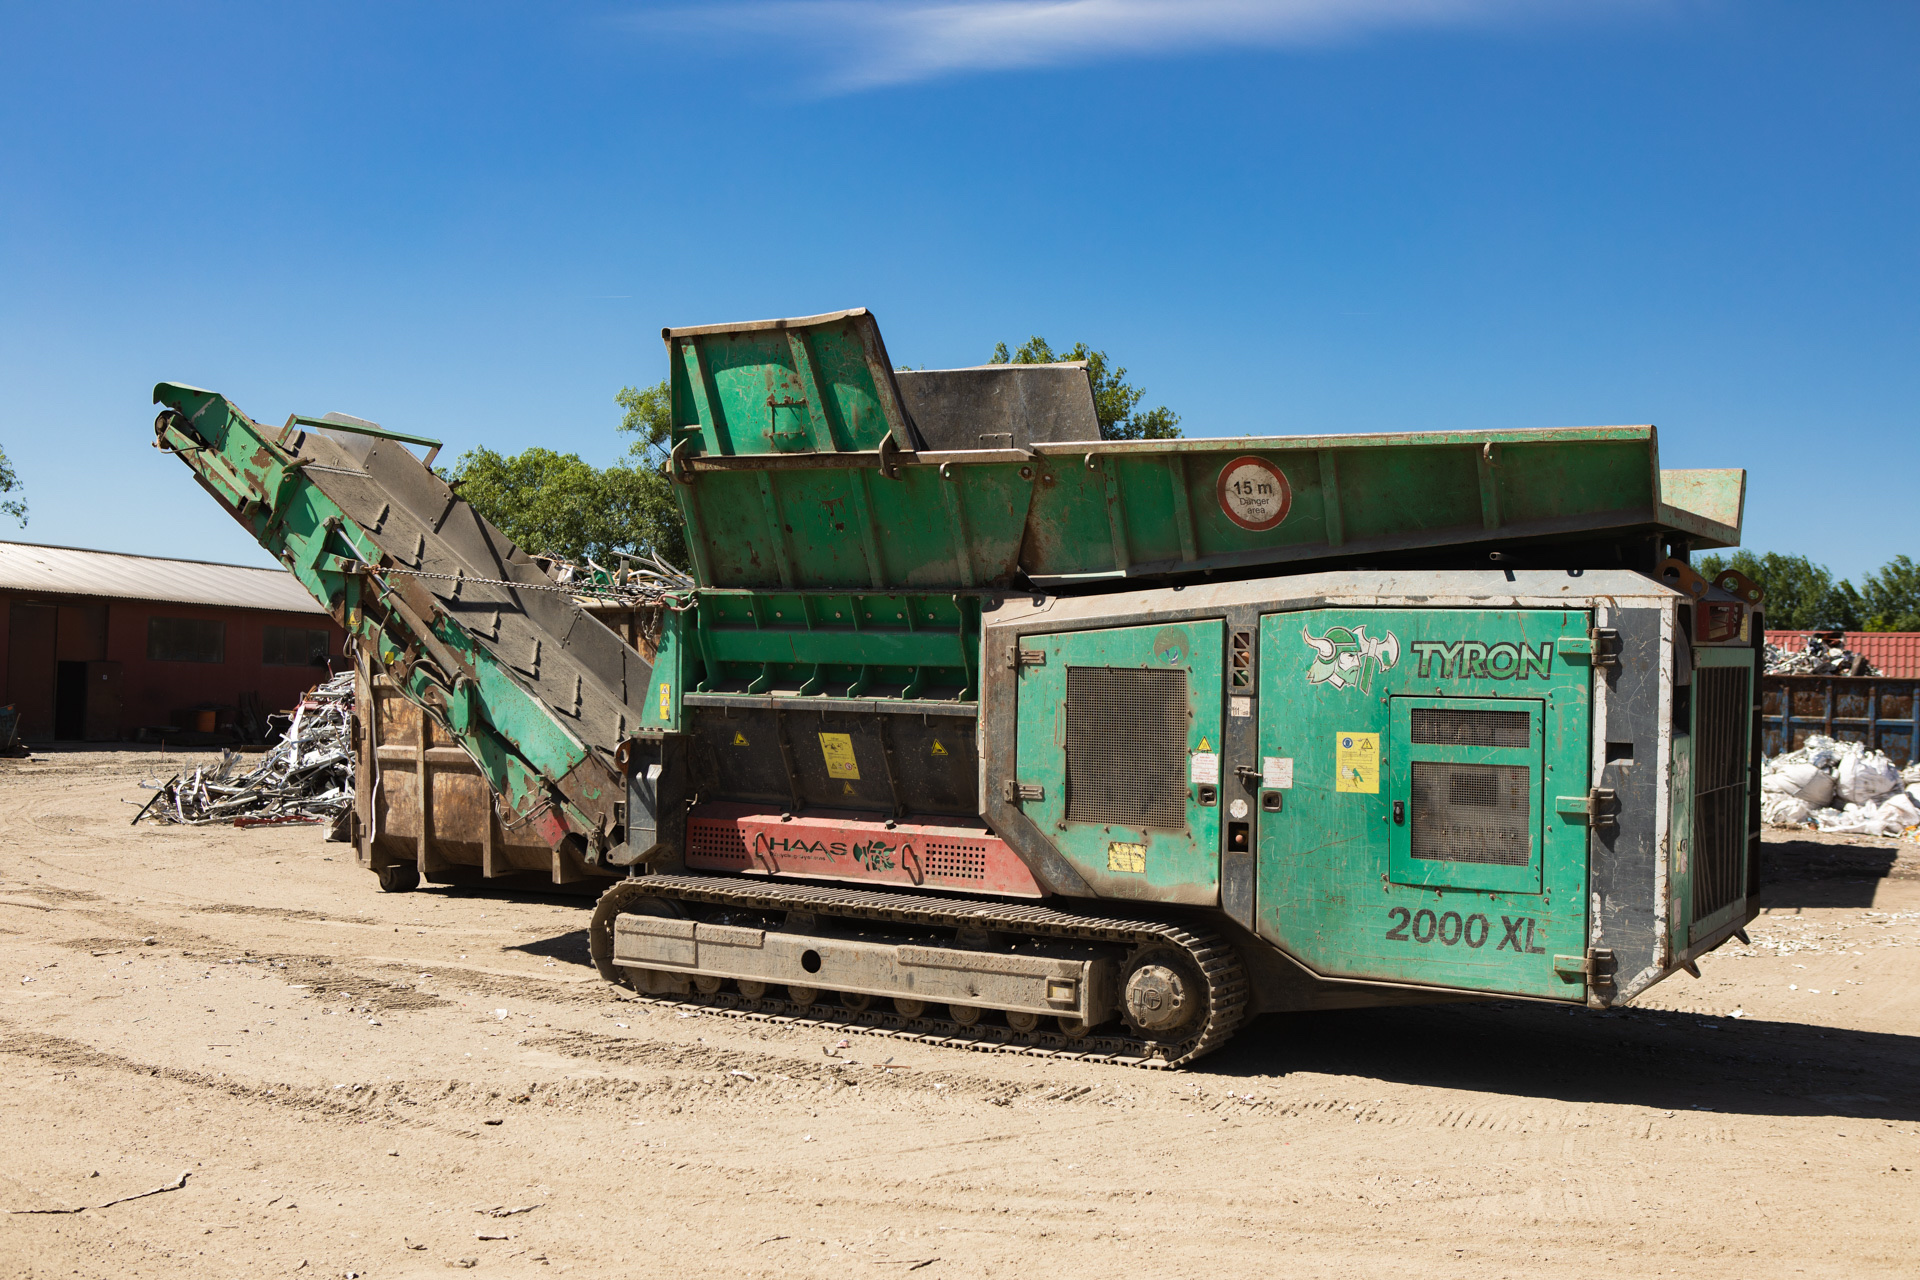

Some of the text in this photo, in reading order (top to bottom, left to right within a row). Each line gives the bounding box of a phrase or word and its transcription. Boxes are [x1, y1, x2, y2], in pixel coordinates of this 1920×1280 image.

[1233, 480, 1273, 495] 15 m
[1239, 497, 1270, 507] Danger
[1410, 640, 1555, 681] TYRON
[769, 837, 848, 863] HAAS
[1385, 906, 1546, 955] 2000 XL
